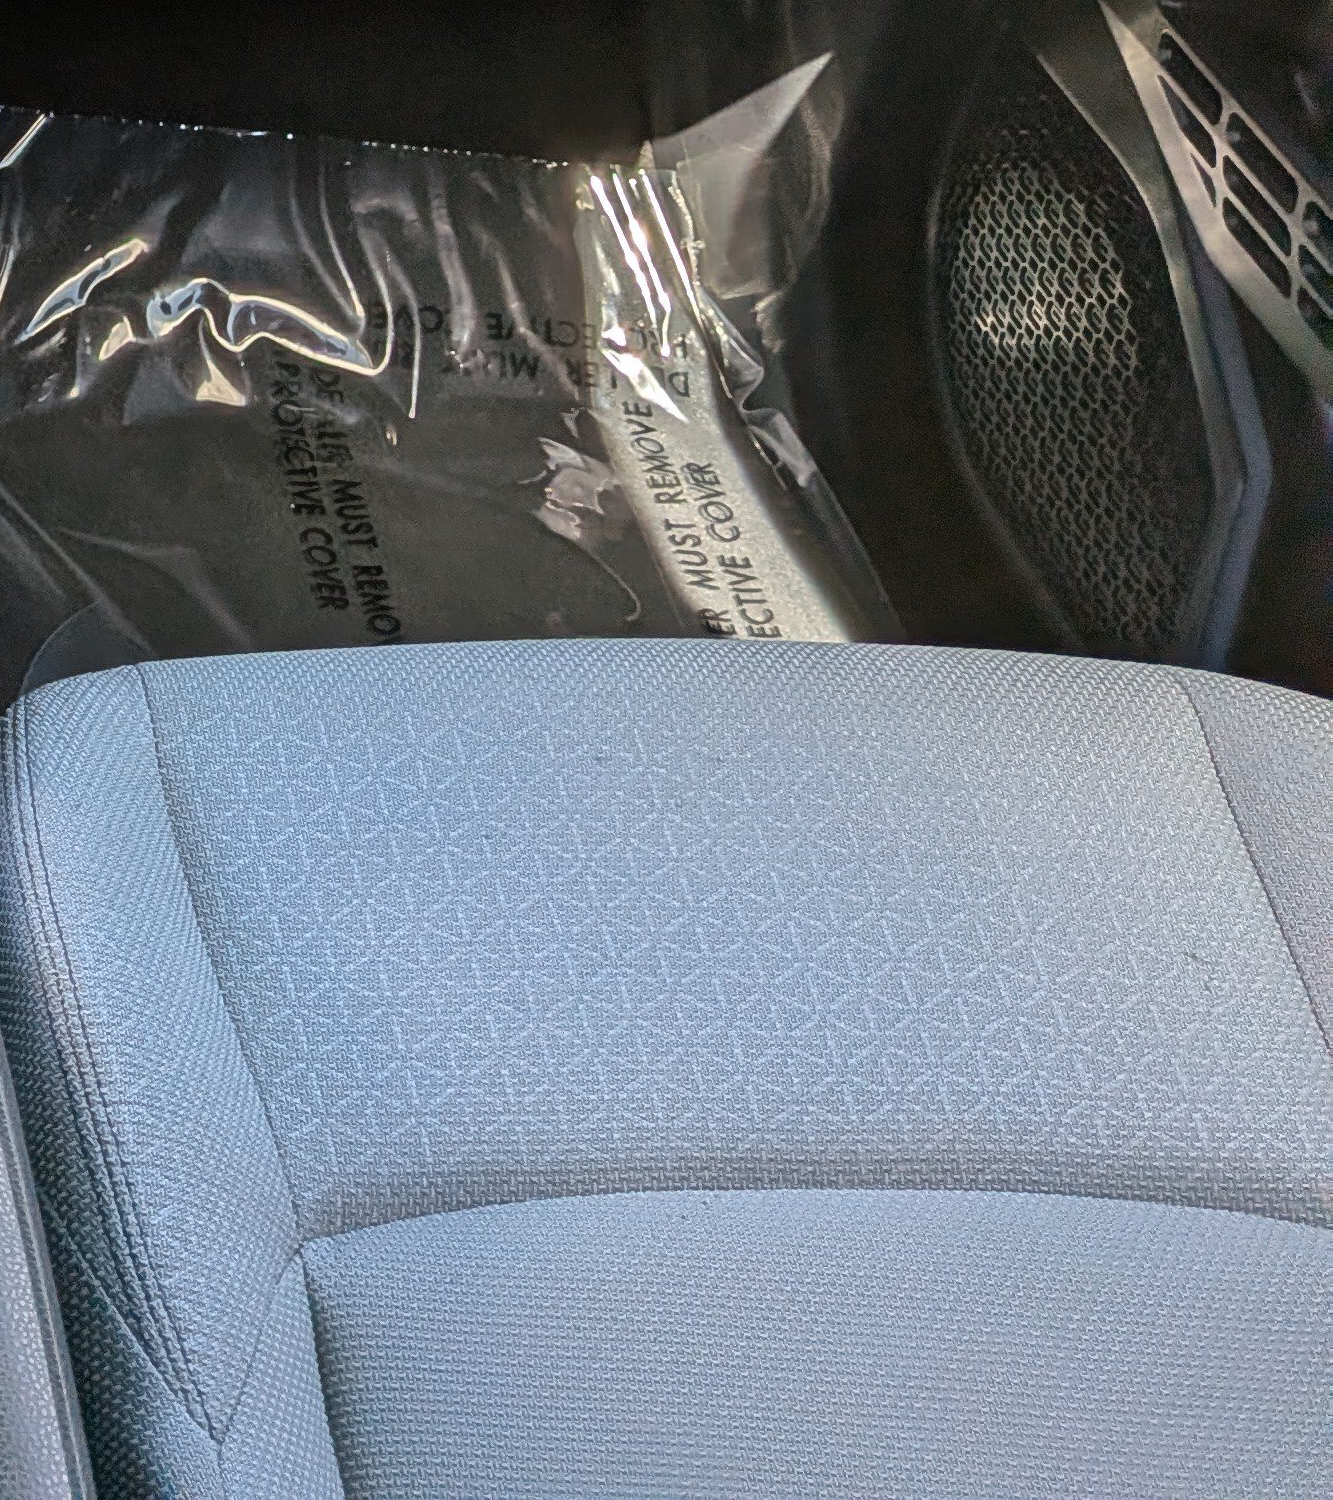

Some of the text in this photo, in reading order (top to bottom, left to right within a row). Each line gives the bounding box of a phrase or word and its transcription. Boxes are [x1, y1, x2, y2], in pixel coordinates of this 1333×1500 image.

[331, 477, 381, 551] MUST
[621, 400, 689, 506] REMOVE
[664, 518, 721, 592] MUST
[680, 461, 743, 544] COVER
[298, 526, 352, 613] COVER
